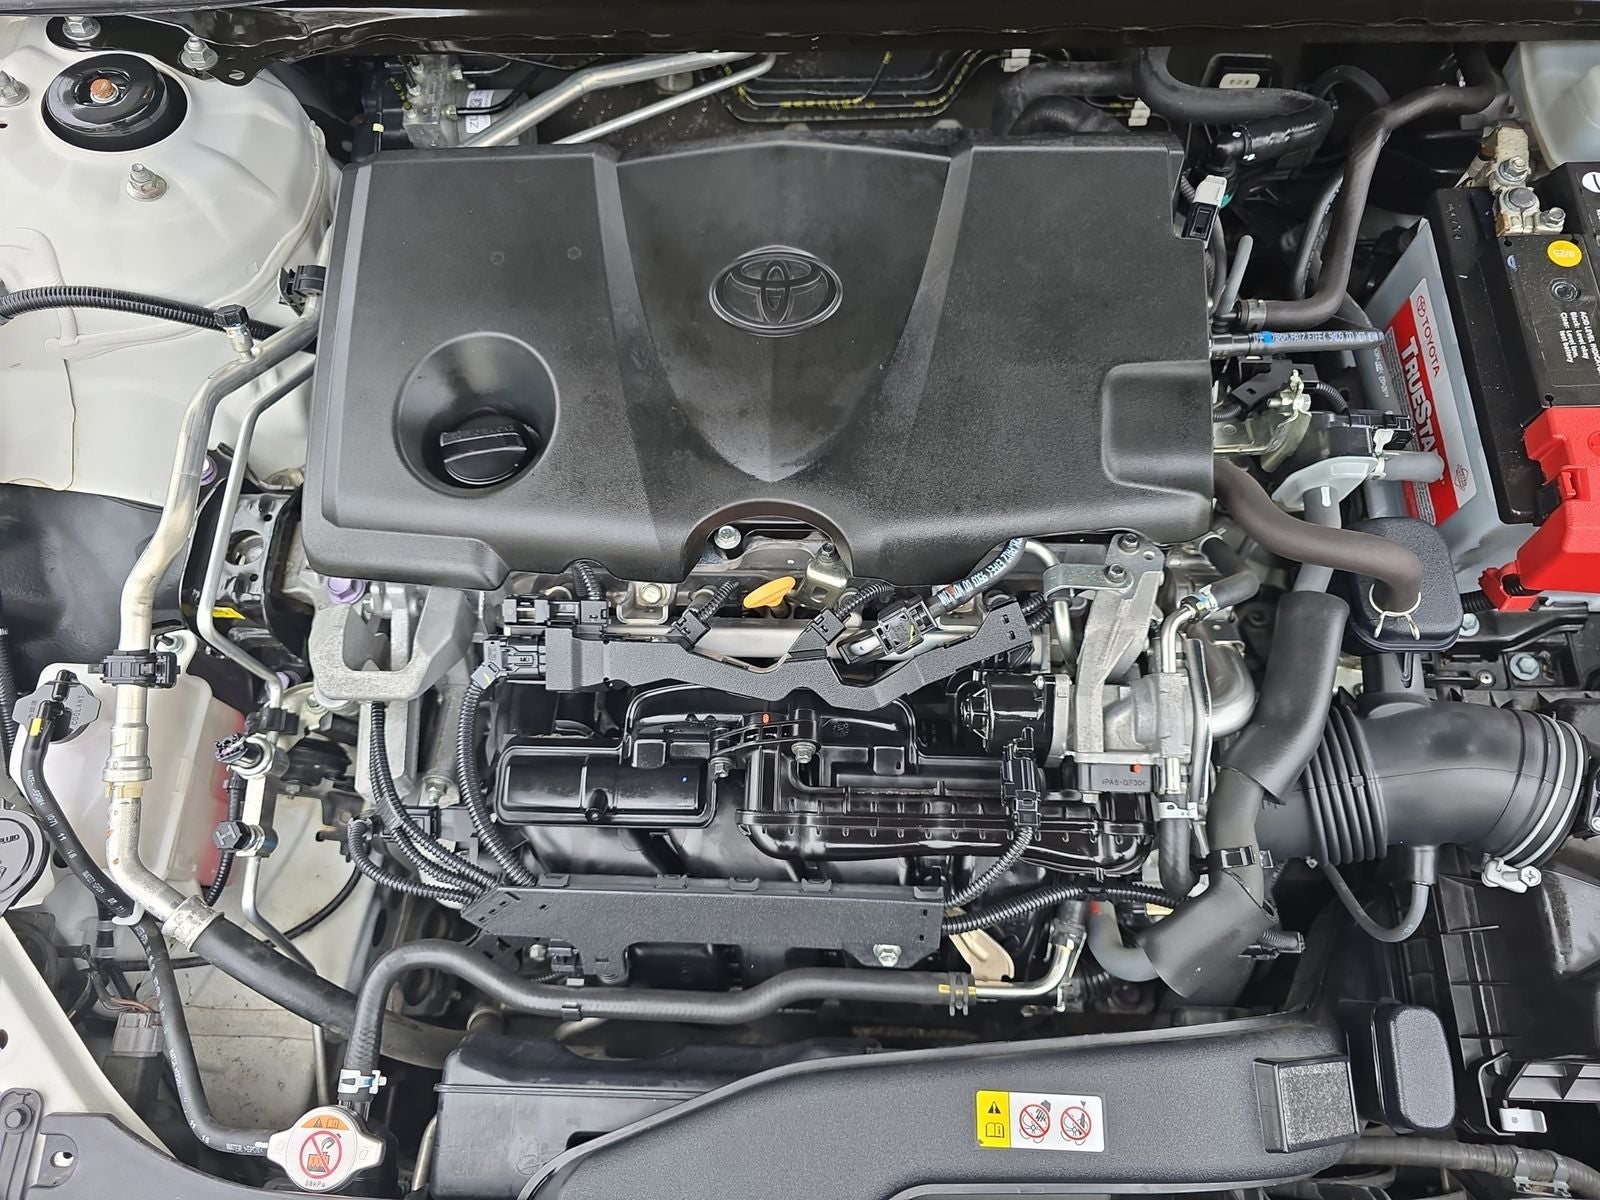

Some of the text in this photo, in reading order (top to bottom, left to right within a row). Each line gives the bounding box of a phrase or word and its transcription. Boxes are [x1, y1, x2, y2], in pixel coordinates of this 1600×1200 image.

[1580, 311, 1590, 325] ACID
[1566, 330, 1577, 345] Level
[1576, 330, 1587, 345] Level
[1584, 326, 1595, 343] LEVEL
[1422, 316, 1441, 377] TOYOTA
[1559, 330, 1574, 363] test battery
[1580, 345, 1590, 360] okay
[1401, 336, 1444, 481] TRUESTA
[71, 695, 85, 726] COOLANT
